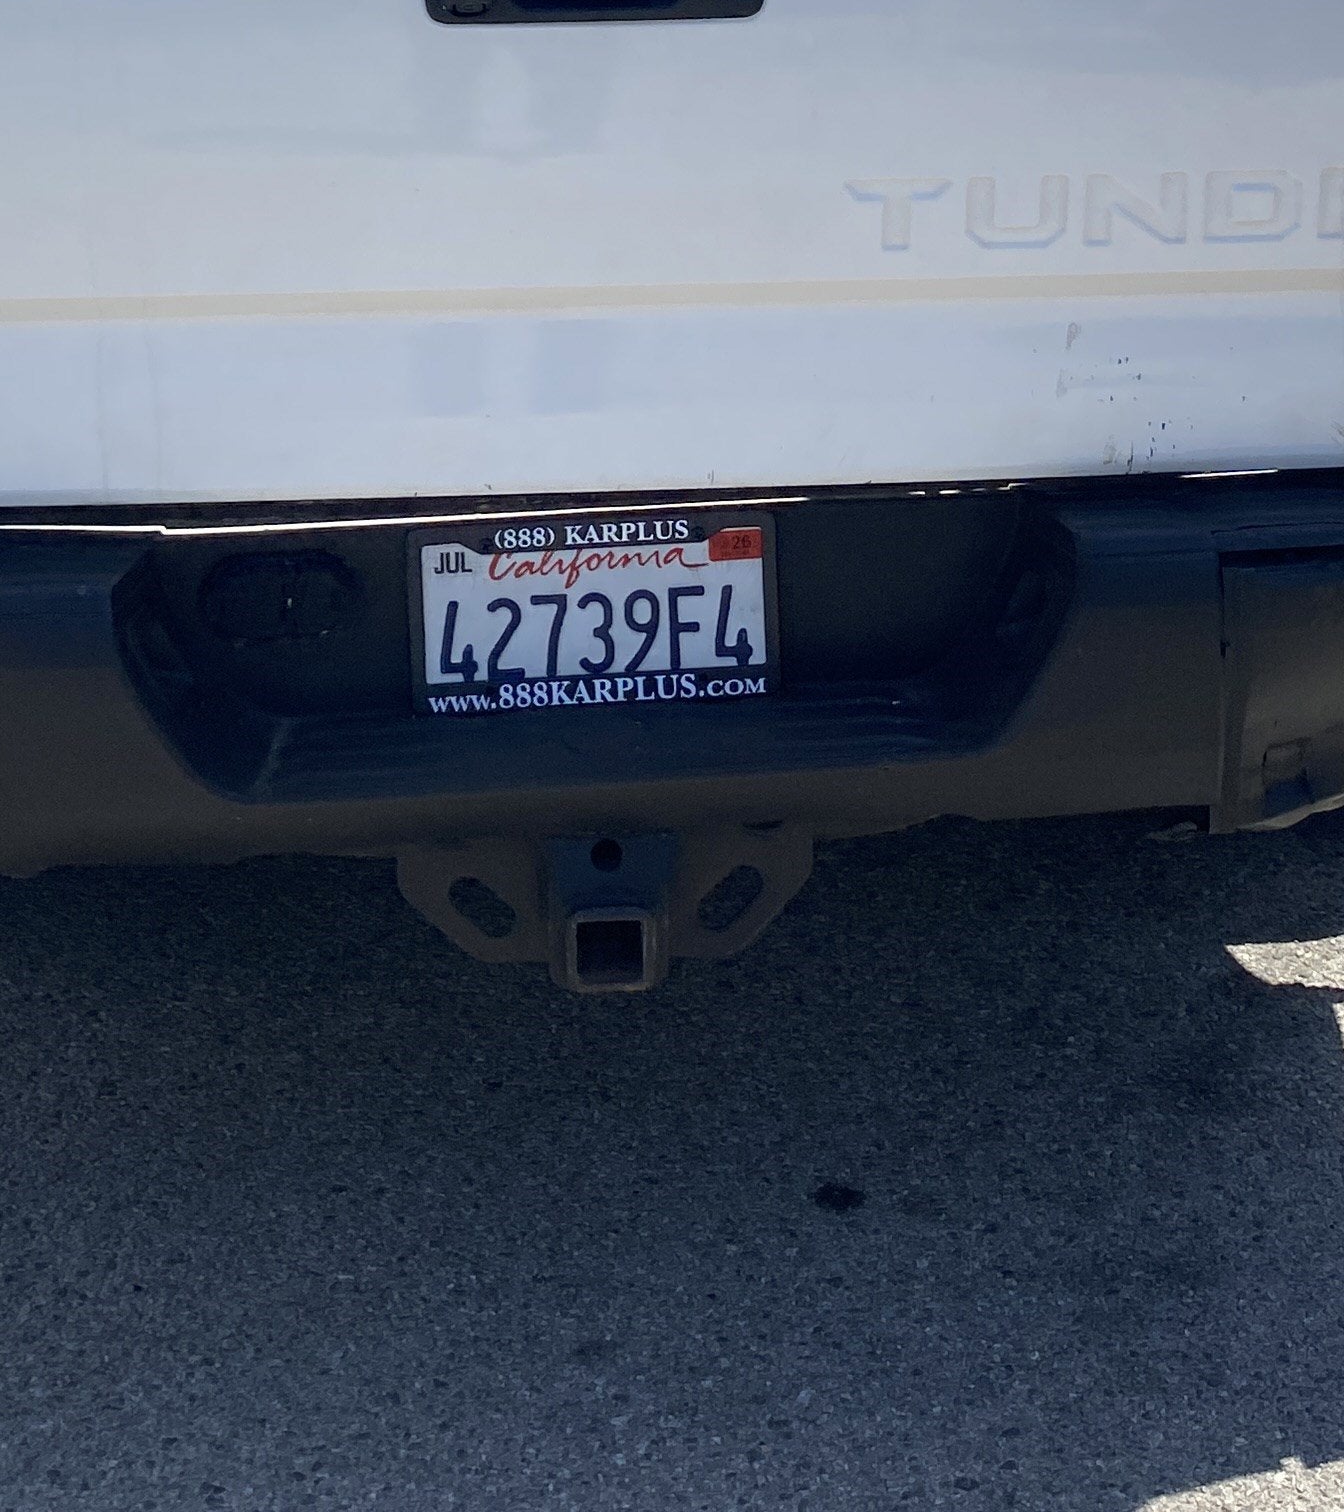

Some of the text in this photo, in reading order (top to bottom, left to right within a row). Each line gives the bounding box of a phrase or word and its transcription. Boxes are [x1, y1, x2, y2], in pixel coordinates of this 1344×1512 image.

[494, 519, 689, 549] (888) KARPLUS
[434, 551, 472, 575] JUL
[440, 585, 753, 683] 42739F4
